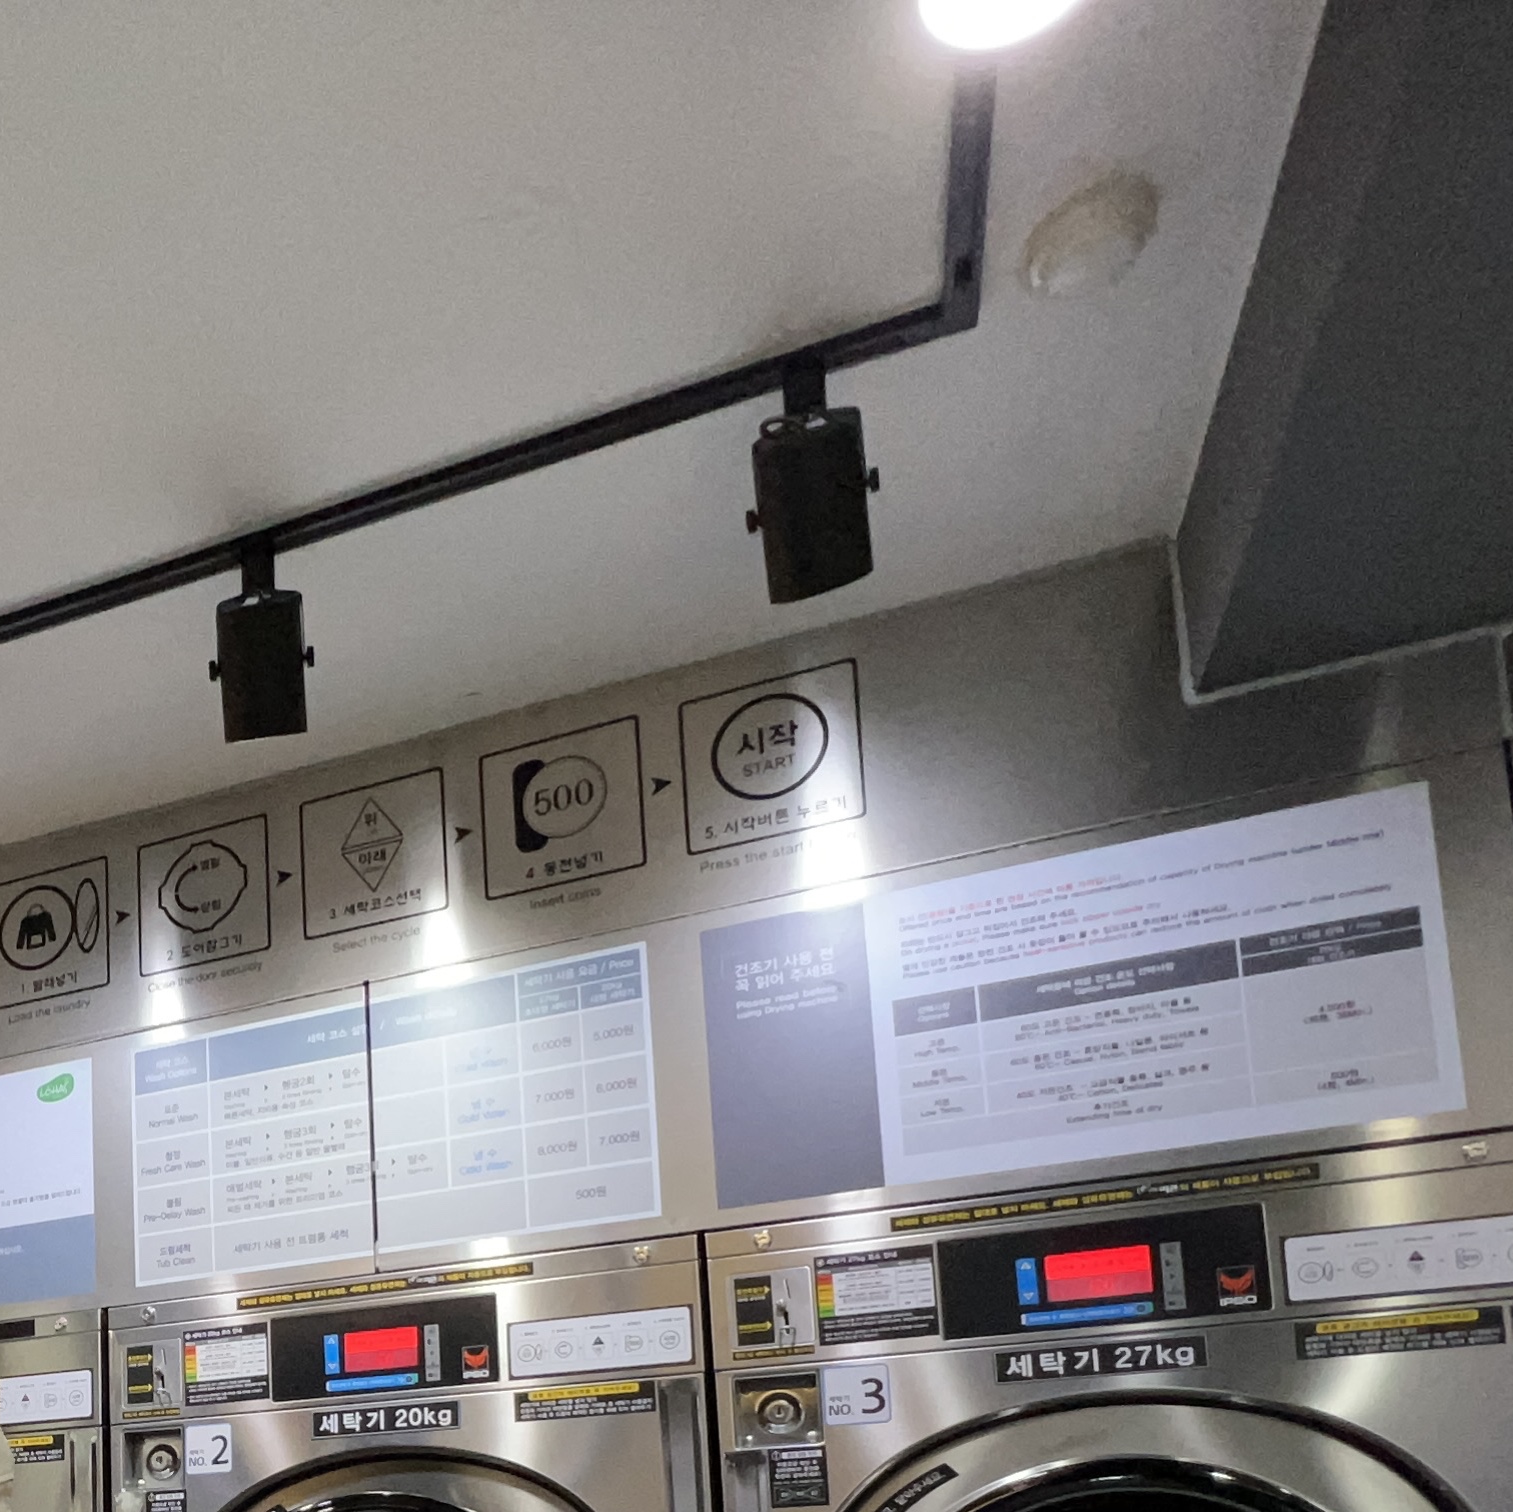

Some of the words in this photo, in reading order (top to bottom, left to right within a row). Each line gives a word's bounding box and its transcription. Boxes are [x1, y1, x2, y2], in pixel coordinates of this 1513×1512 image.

[737, 719, 800, 755] 시작
[742, 753, 797, 779] START
[533, 778, 594, 817] 500
[364, 811, 378, 827] 위
[723, 807, 790, 835] 시작버튼
[796, 795, 848, 819] 누르기
[357, 848, 388, 867] 아래
[543, 850, 604, 876] 동전넣기
[699, 854, 742, 874] Press
[744, 846, 769, 864] the
[342, 887, 423, 917] 세탁코스선택
[332, 937, 368, 955] Select
[370, 933, 388, 946] the
[390, 925, 421, 943] cycle
[734, 957, 778, 977] 건조기
[783, 950, 813, 969] 사용
[818, 945, 836, 964] 전
[735, 976, 750, 992] 꼭
[753, 970, 784, 989] 읽어
[789, 961, 836, 984] 주세요
[35, 1006, 51, 1019] the
[736, 995, 772, 1011] Please
[774, 990, 800, 1004] read
[764, 1001, 795, 1017] Drying
[148, 1114, 175, 1128] Normal
[176, 1111, 199, 1125] Wash
[140, 1163, 163, 1177] Fresh
[184, 1158, 207, 1172] Wash
[183, 1206, 206, 1219] Wash
[156, 1257, 171, 1269] Tub
[172, 1255, 196, 1268] Clean
[1005, 1348, 1101, 1380] 세탁기
[1114, 1342, 1197, 1370] 27kg
[829, 1403, 854, 1416] NO.
[860, 1377, 887, 1415] 3
[318, 1406, 386, 1434] 세탁기
[393, 1406, 454, 1431] 20kg
[188, 1456, 207, 1468] NO.
[210, 1434, 229, 1466] 2
